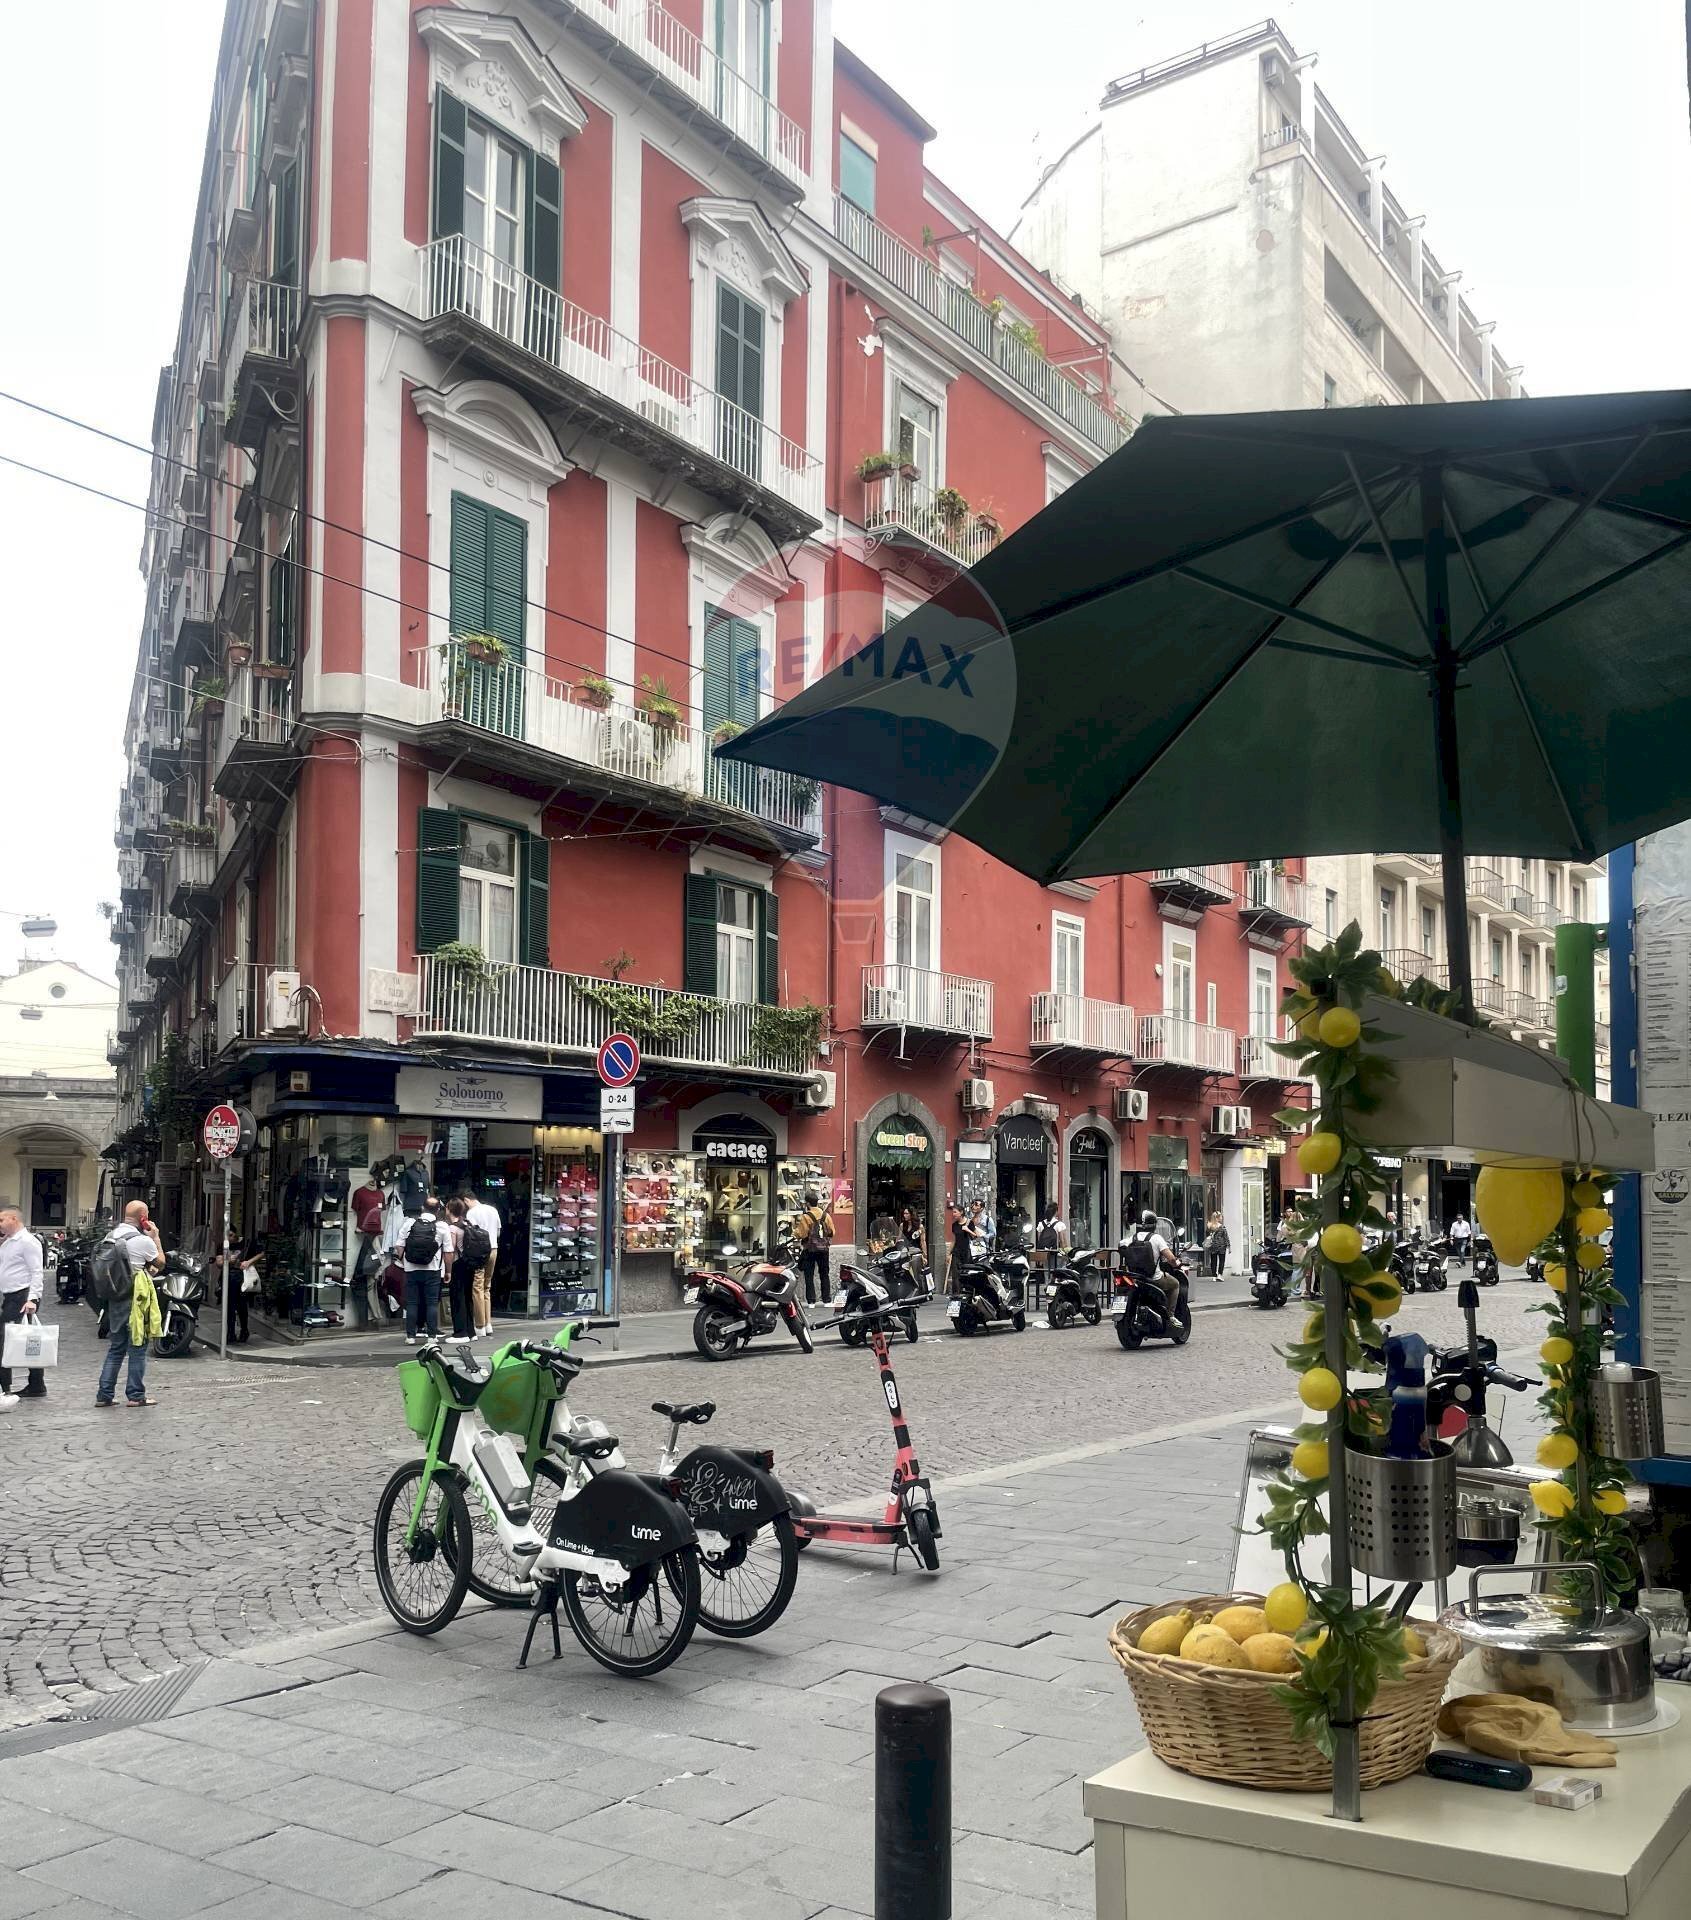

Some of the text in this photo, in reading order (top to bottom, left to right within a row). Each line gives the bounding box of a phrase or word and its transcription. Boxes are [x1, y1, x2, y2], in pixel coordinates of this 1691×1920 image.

[439, 1082, 504, 1101] Solouomo
[608, 1094, 627, 1104] 0-24
[1655, 1112, 1691, 1122] LEZI
[878, 1132, 927, 1151] Green Stop
[1003, 1132, 1045, 1154] Vancleef
[706, 1142, 768, 1159] cacace
[729, 1496, 758, 1510] Lime
[631, 1524, 661, 1541] Lime
[555, 1536, 565, 1546] On
[564, 1538, 577, 1550] Lime
[581, 1544, 595, 1555] Uber
